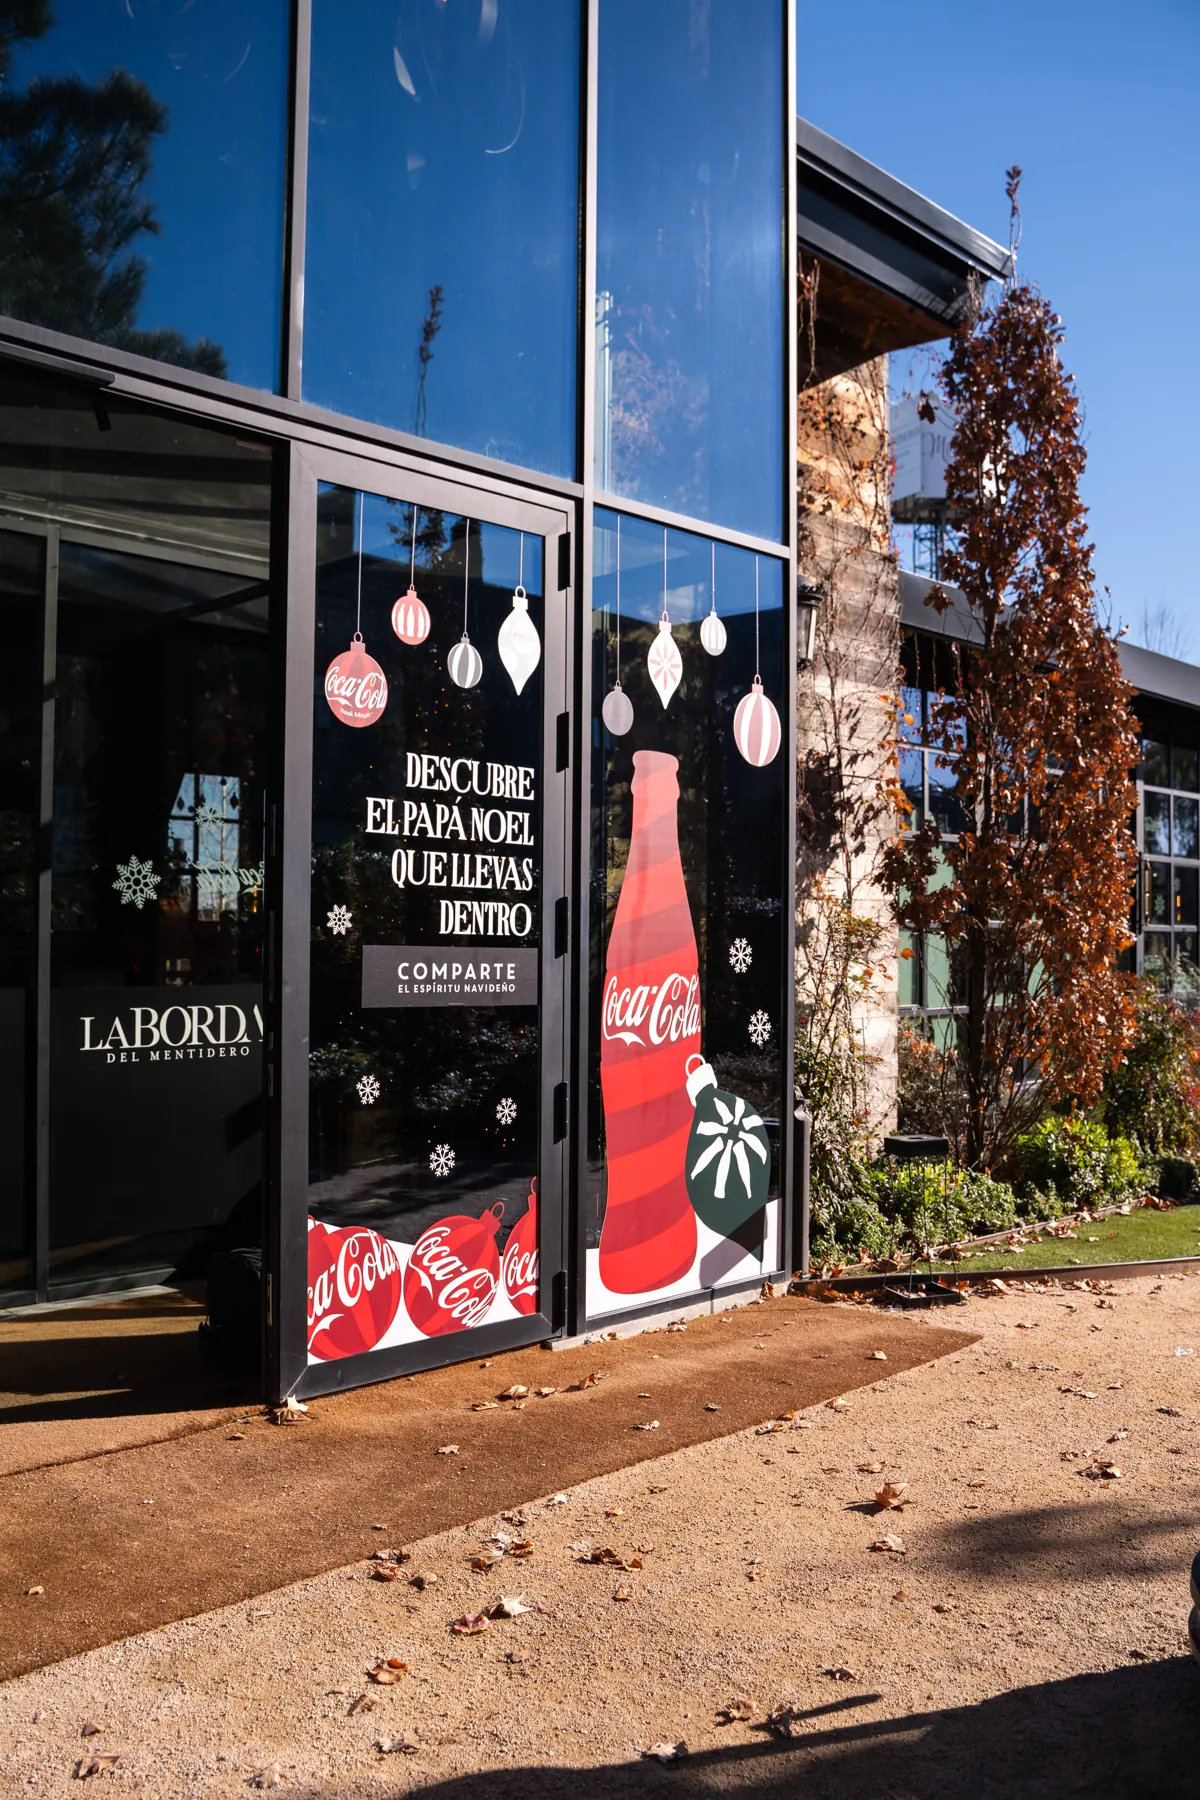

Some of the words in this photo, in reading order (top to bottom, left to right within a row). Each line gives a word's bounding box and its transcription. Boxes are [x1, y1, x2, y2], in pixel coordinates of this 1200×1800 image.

[406, 752, 534, 800] DESCUBRE
[365, 797, 399, 834] EL
[402, 796, 467, 840] PAPÁ
[470, 807, 534, 846] NOEL
[391, 848, 447, 888] QUE
[451, 853, 533, 891] LLEVAS
[439, 900, 532, 936] DENTRO
[397, 962, 516, 980] COMPARTE
[398, 984, 409, 993] EL
[413, 982, 460, 993] ESPÍRITU
[464, 982, 516, 993] NAVIDEÑO
[603, 973, 700, 1047] Coca-Cola
[106, 1052, 140, 1063] DEL
[150, 1046, 250, 1061] MENTIDERO
[308, 1229, 400, 1338] ca-Cola
